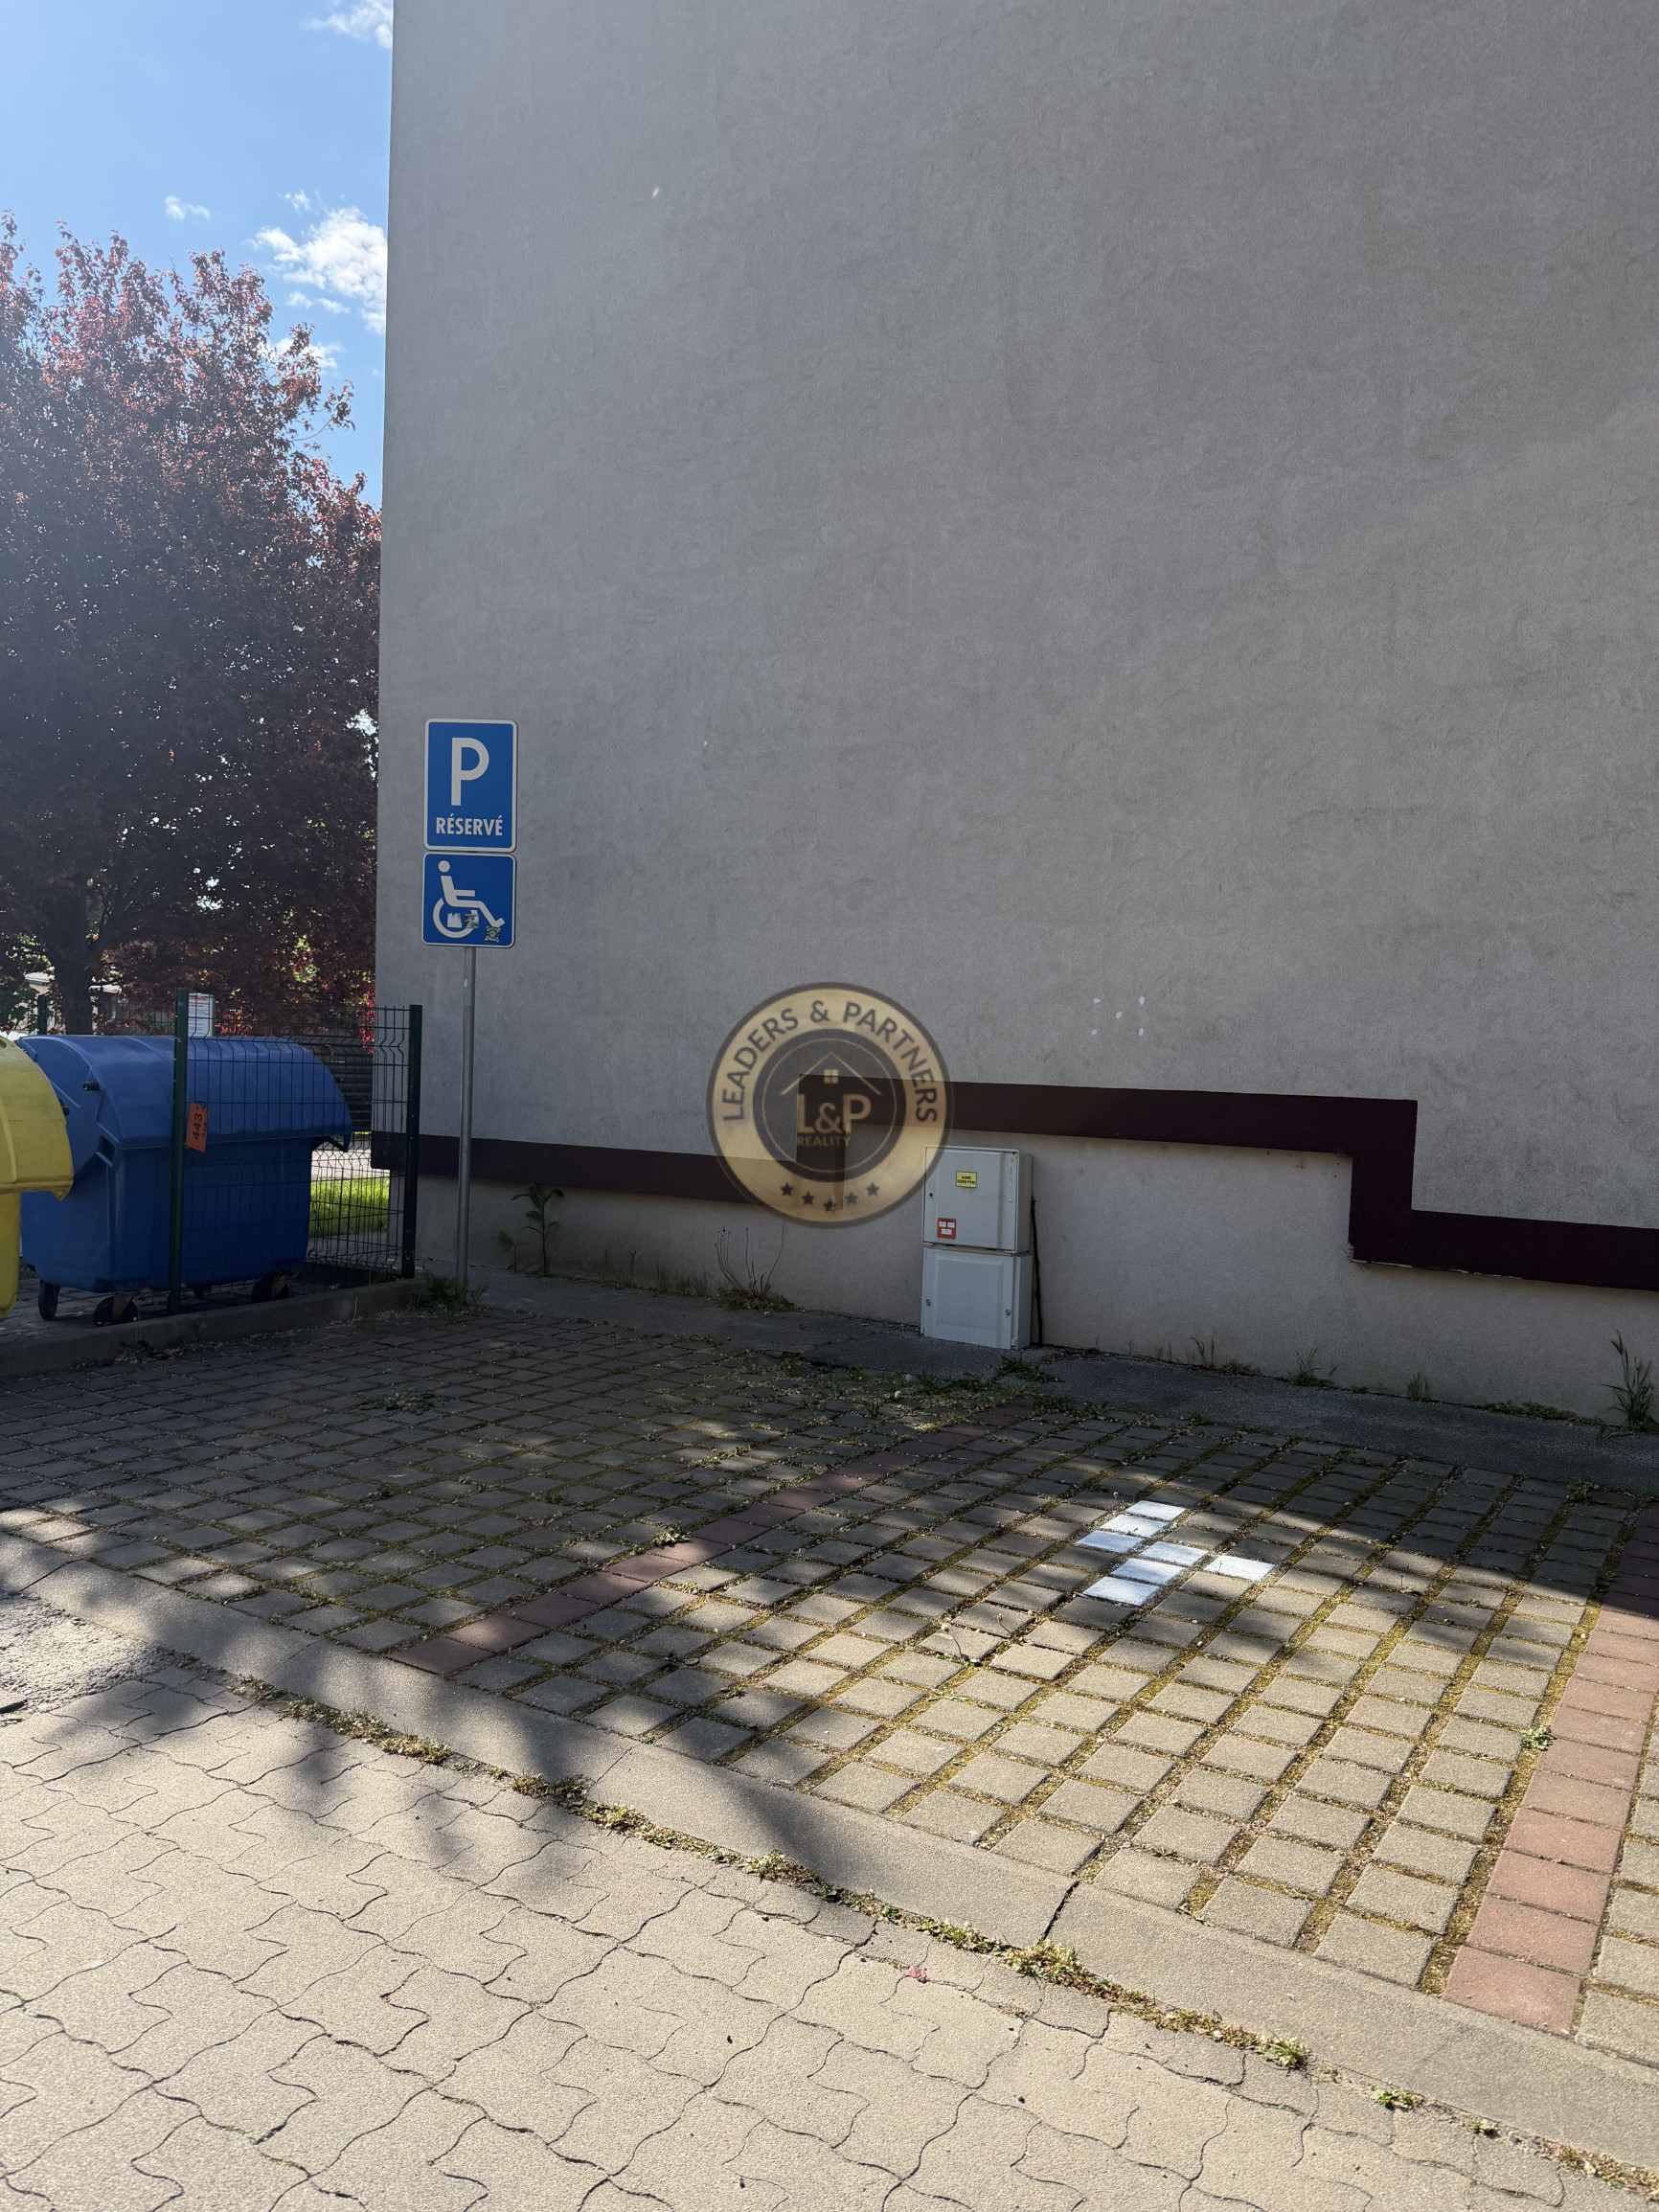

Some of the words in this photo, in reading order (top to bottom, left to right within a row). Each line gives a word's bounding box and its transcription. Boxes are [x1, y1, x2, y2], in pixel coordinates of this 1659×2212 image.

[451, 737, 490, 807] P
[436, 812, 504, 836] RÉSERVÉ
[193, 1112, 203, 1141] 443
